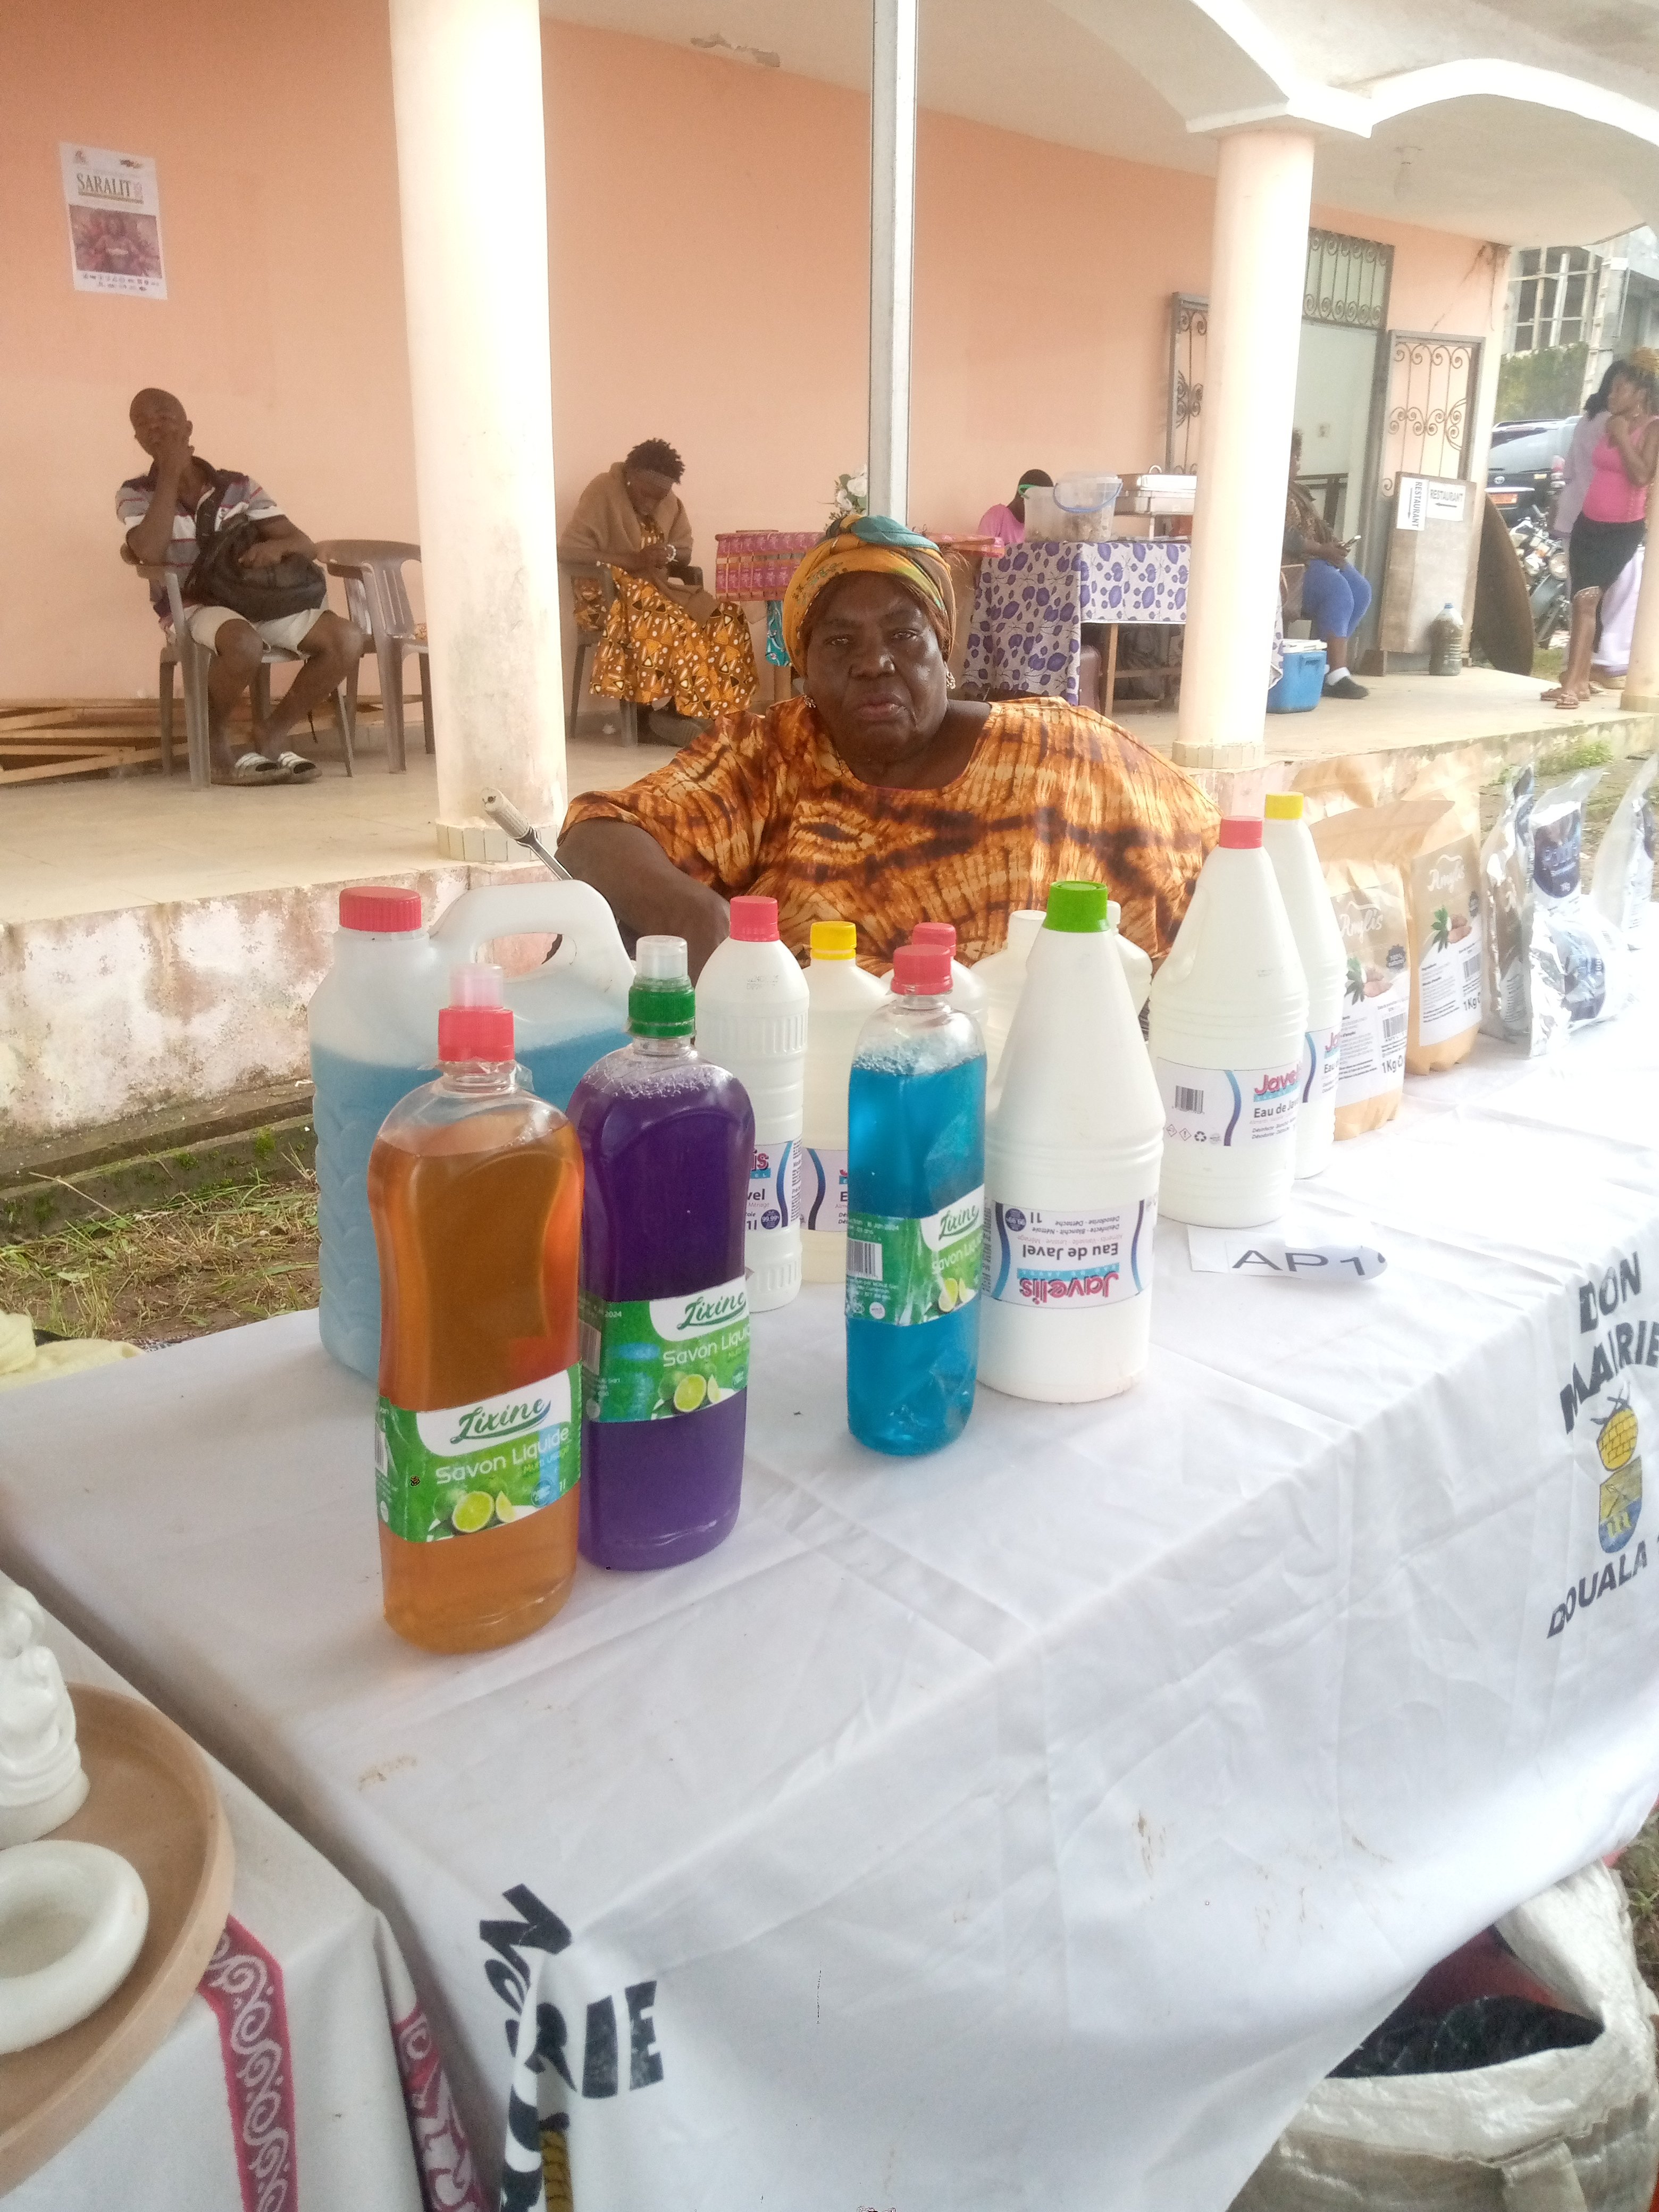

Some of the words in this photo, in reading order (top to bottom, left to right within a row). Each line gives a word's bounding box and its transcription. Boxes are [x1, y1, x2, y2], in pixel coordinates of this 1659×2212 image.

[1412, 482, 1422, 527] RESTAURANT
[1430, 489, 1463, 502] RESTAURANT
[1254, 1108, 1273, 1118] Eau
[1276, 1103, 1286, 1114] de
[747, 1188, 765, 1201] vel
[1022, 1244, 1063, 1260] Javel
[1068, 1247, 1087, 1260] de
[1093, 1243, 1119, 1256] Eau
[1019, 1271, 1119, 1305] Javelis
[1579, 1251, 1642, 1334] DON
[663, 1342, 717, 1367] Savon
[435, 1456, 506, 1485] Savon
[512, 1427, 569, 1465] Liquide
[1547, 1540, 1647, 1639] DOUALA
